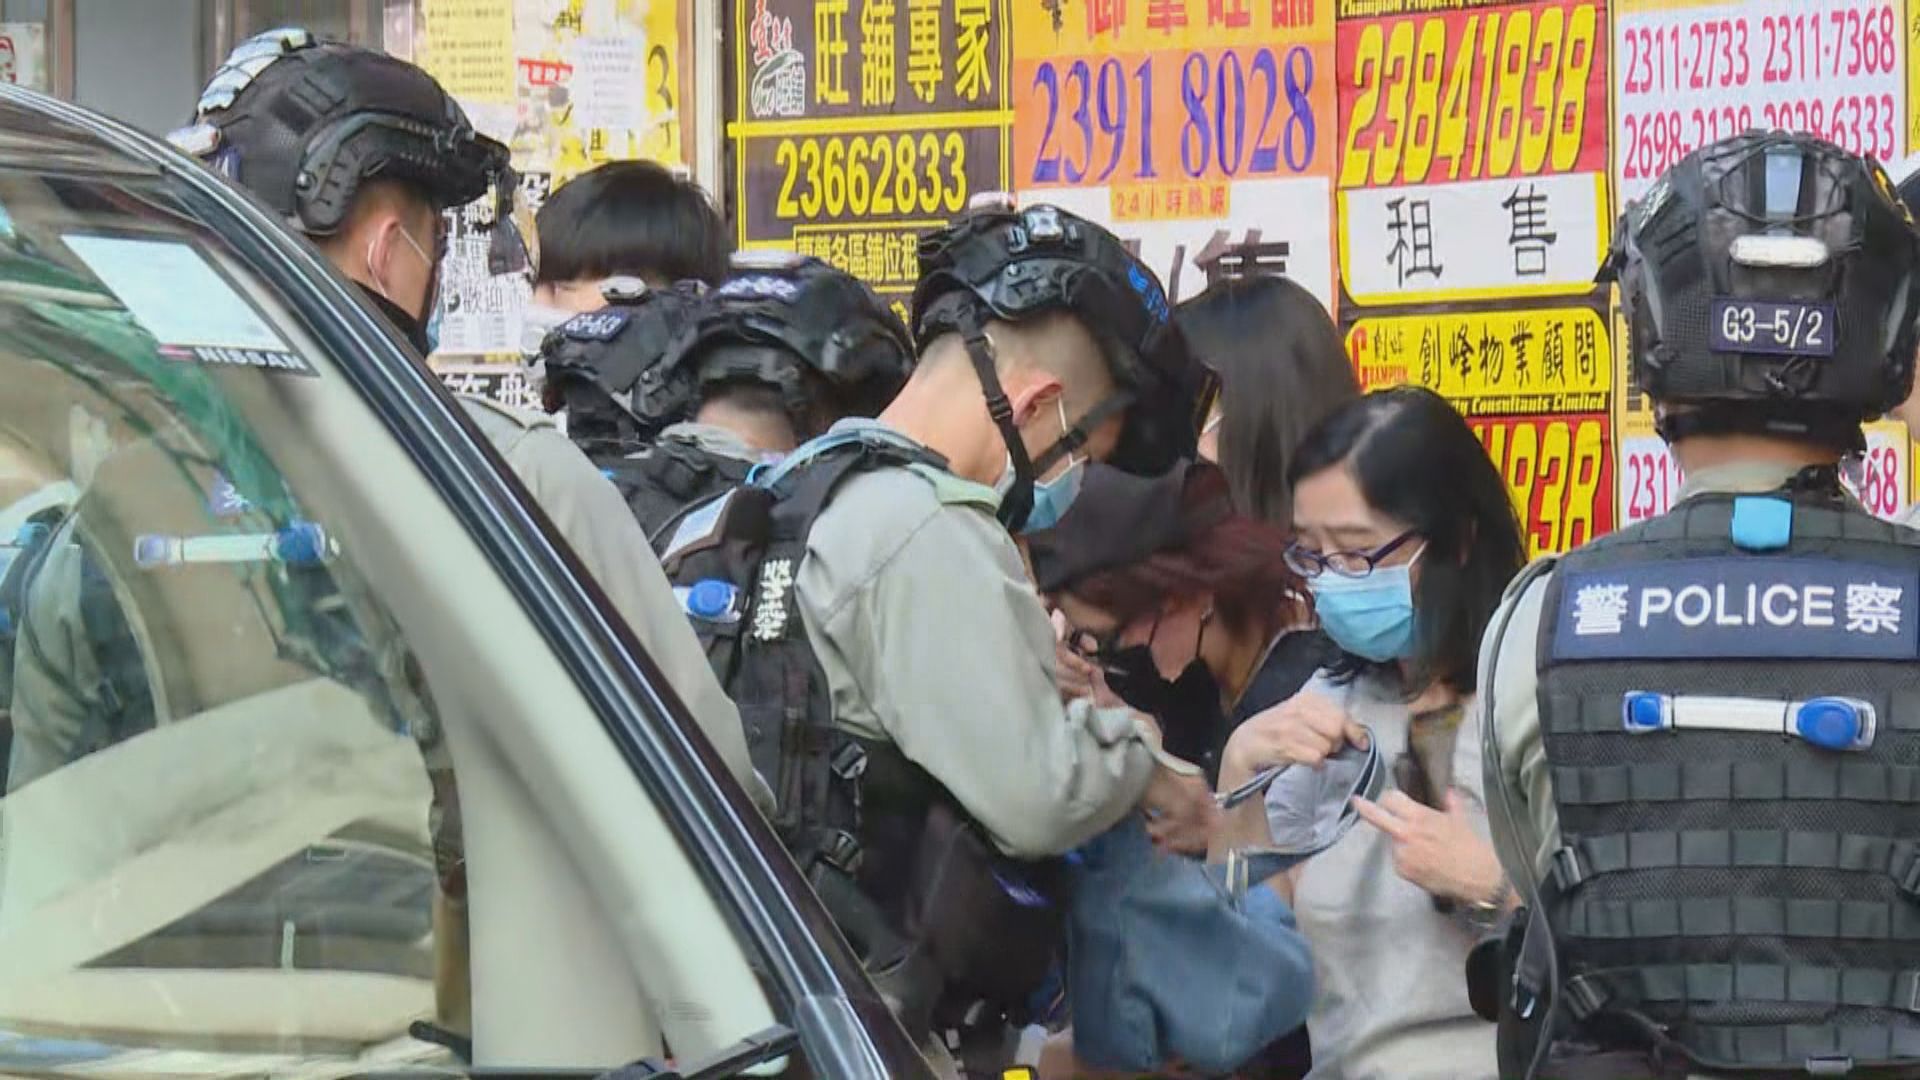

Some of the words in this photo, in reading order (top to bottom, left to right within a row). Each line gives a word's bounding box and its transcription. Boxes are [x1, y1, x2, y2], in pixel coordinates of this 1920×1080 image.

[1032, 57, 1159, 183] 2391
[1181, 46, 1316, 178] 8028
[1338, 4, 1597, 188] 23841838
[775, 131, 968, 218] 23662833
[194, 347, 307, 370] NISSAN
[1419, 318, 1598, 389] 創峰物業顧問
[1722, 305, 1824, 349] G3-5/2
[1572, 583, 1630, 636] 警
[1638, 583, 1836, 628] POLICE
[1844, 581, 1904, 635] 察
